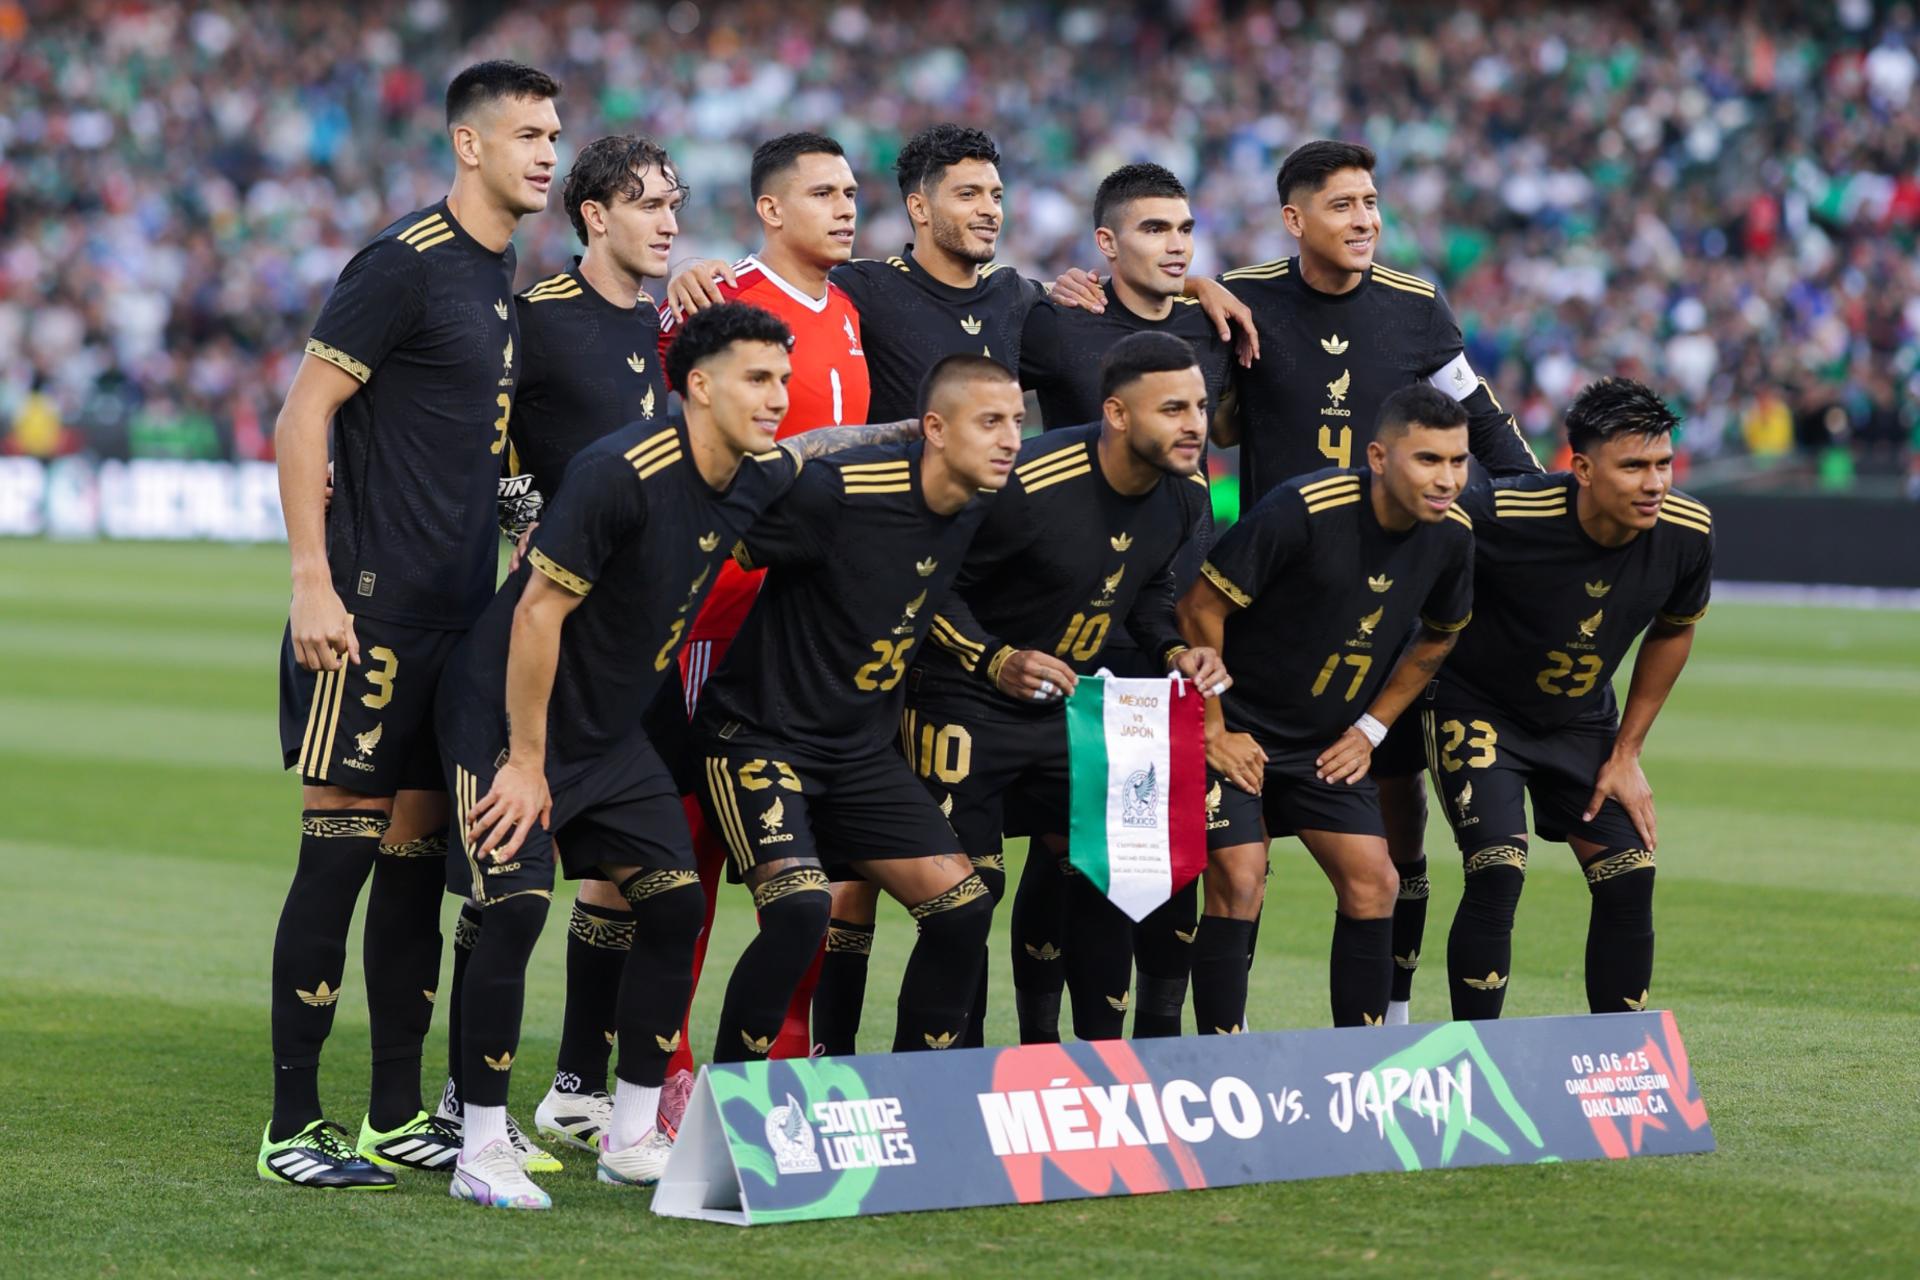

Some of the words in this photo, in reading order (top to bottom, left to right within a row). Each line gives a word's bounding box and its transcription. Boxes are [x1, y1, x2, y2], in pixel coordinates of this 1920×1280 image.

[830, 368, 843, 426] 1
[1320, 407, 1351, 417] MÉXICO
[490, 393, 510, 454] 3
[1318, 424, 1352, 469] 4
[1055, 612, 1111, 661] 10
[361, 646, 399, 710] 3
[853, 637, 915, 691] 25
[1311, 652, 1373, 702] 17
[1536, 650, 1603, 697] 23
[342, 757, 376, 772] MÉXICO
[920, 722, 972, 784] 10
[1440, 719, 1498, 772] 23
[759, 833, 794, 845] MÉXICO
[1124, 815, 1156, 826] MÉXICO
[1565, 1077, 1615, 1095] OAKLAND
[1615, 1074, 1671, 1092] COLISEUM
[1571, 1051, 1650, 1074] 09.06.25
[977, 1076, 1263, 1156] MÉXICO
[1323, 1058, 1472, 1141] JAPAN
[1581, 1096, 1648, 1118] OAKLAND,
[1647, 1094, 1669, 1113] CA
[821, 1132, 918, 1171] LOCALES
